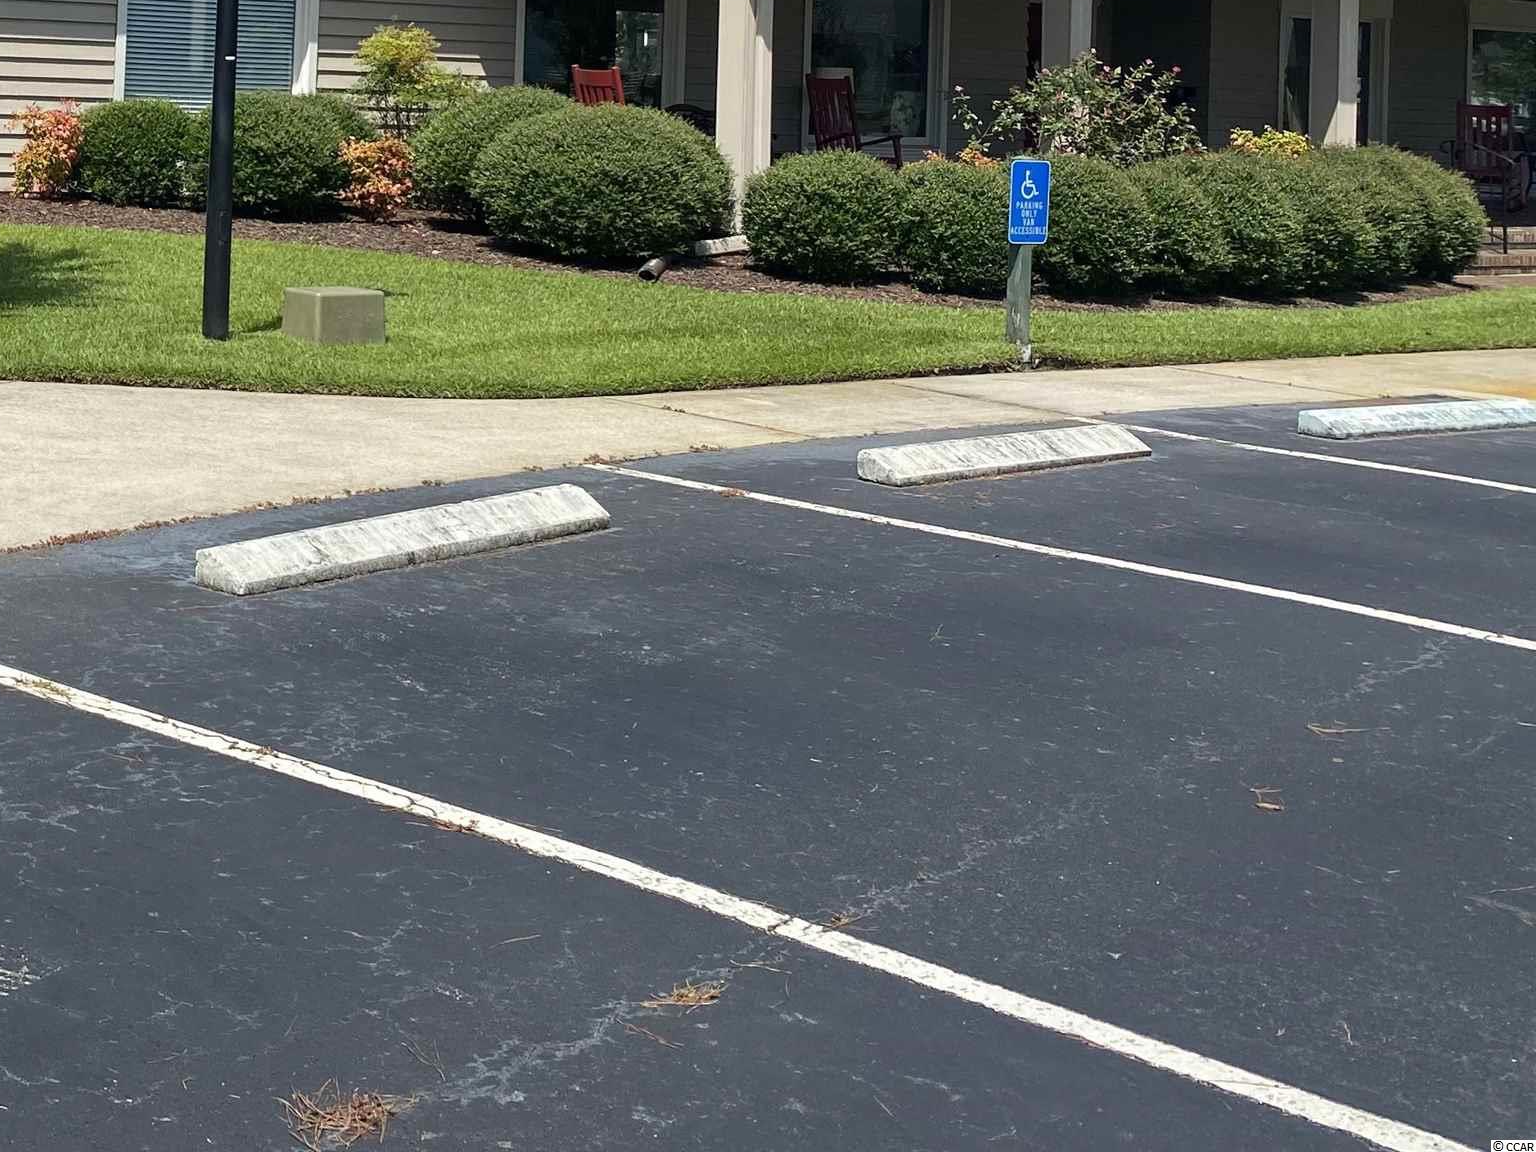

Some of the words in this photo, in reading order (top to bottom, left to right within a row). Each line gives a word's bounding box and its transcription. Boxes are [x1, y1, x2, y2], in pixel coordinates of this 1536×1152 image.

[1016, 201, 1043, 210] PARKING
[1021, 209, 1037, 218] ONLY
[1023, 218, 1035, 226] VAN
